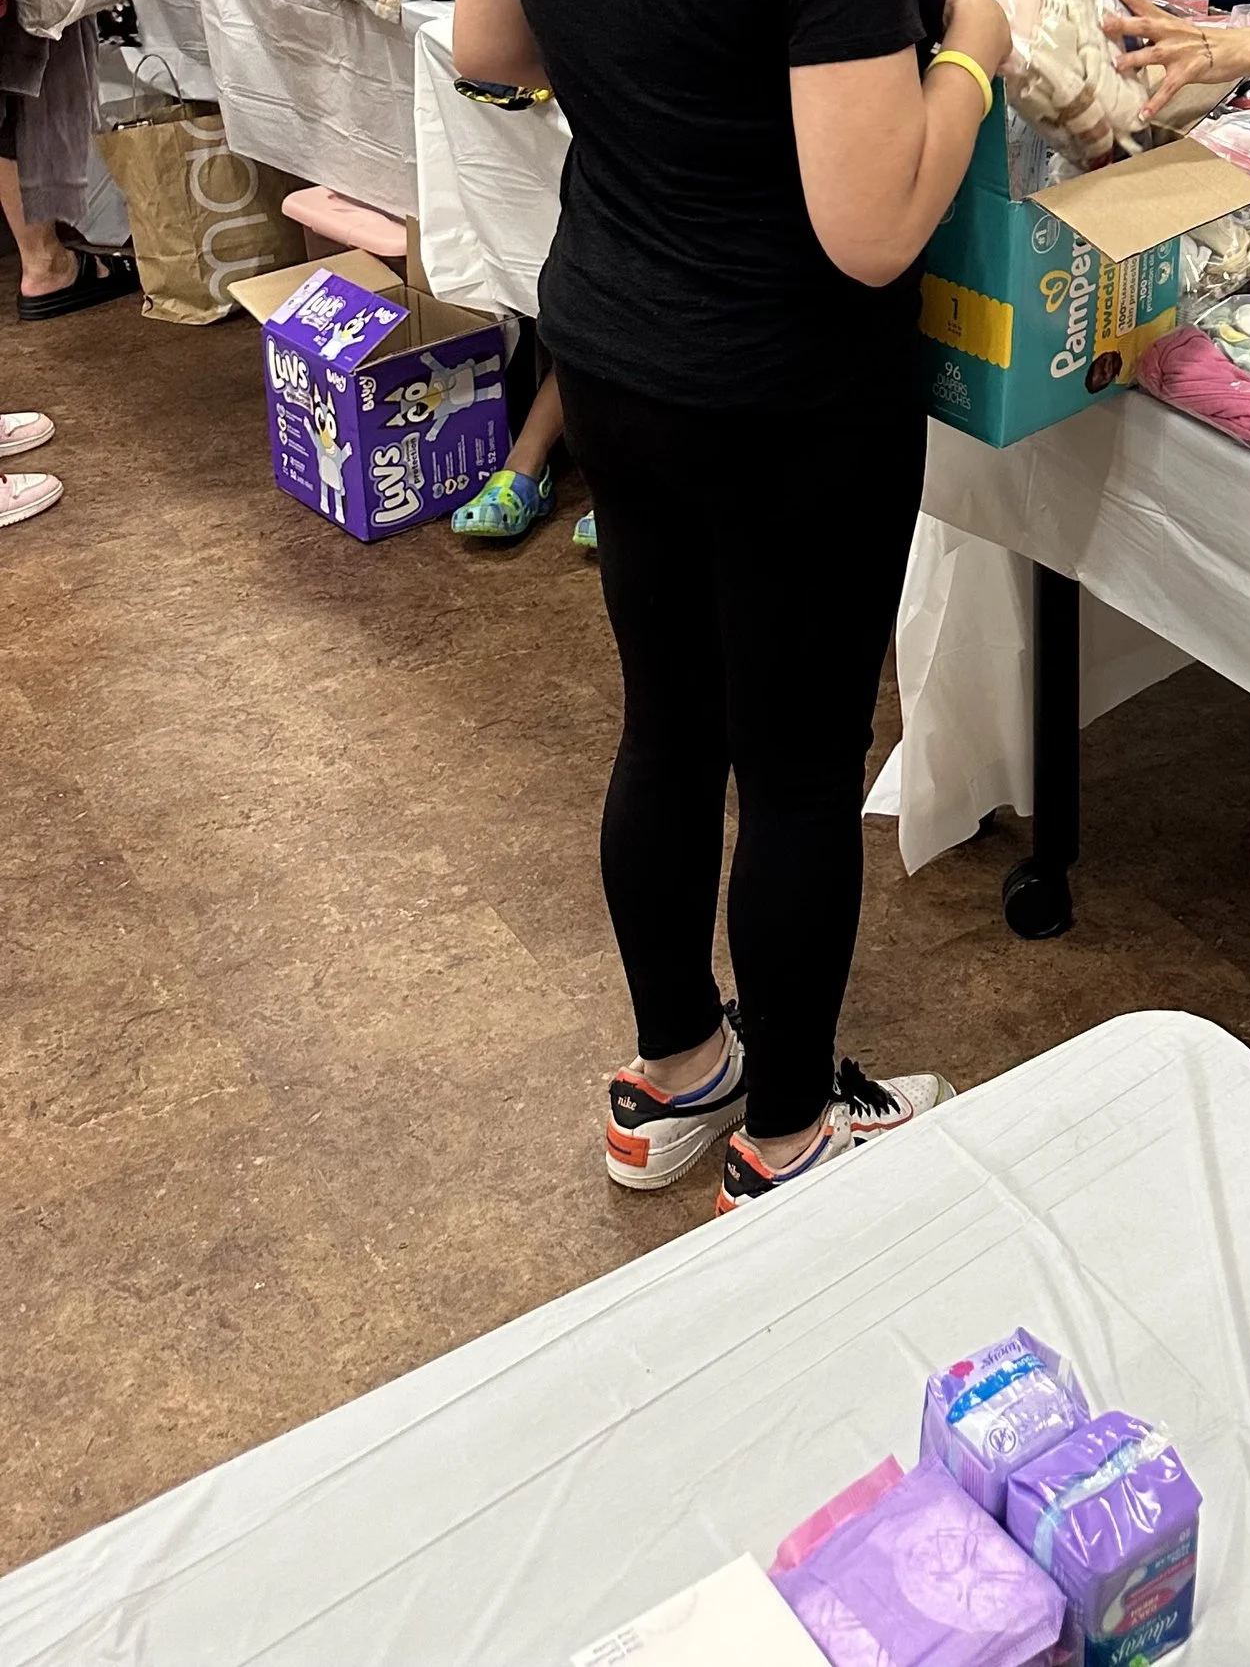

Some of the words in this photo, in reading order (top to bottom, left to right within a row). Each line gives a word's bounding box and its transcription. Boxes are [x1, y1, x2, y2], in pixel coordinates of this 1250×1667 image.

[1050, 232, 1097, 379] Pamper
[1102, 263, 1116, 340] swaddl
[1128, 257, 1138, 306] protectio
[267, 337, 309, 391] Luvs
[937, 373, 968, 396] DIAPERS
[944, 361, 961, 381] 96
[932, 383, 972, 411] COUCHES
[371, 445, 421, 524] Luvs
[617, 1095, 637, 1111] nike
